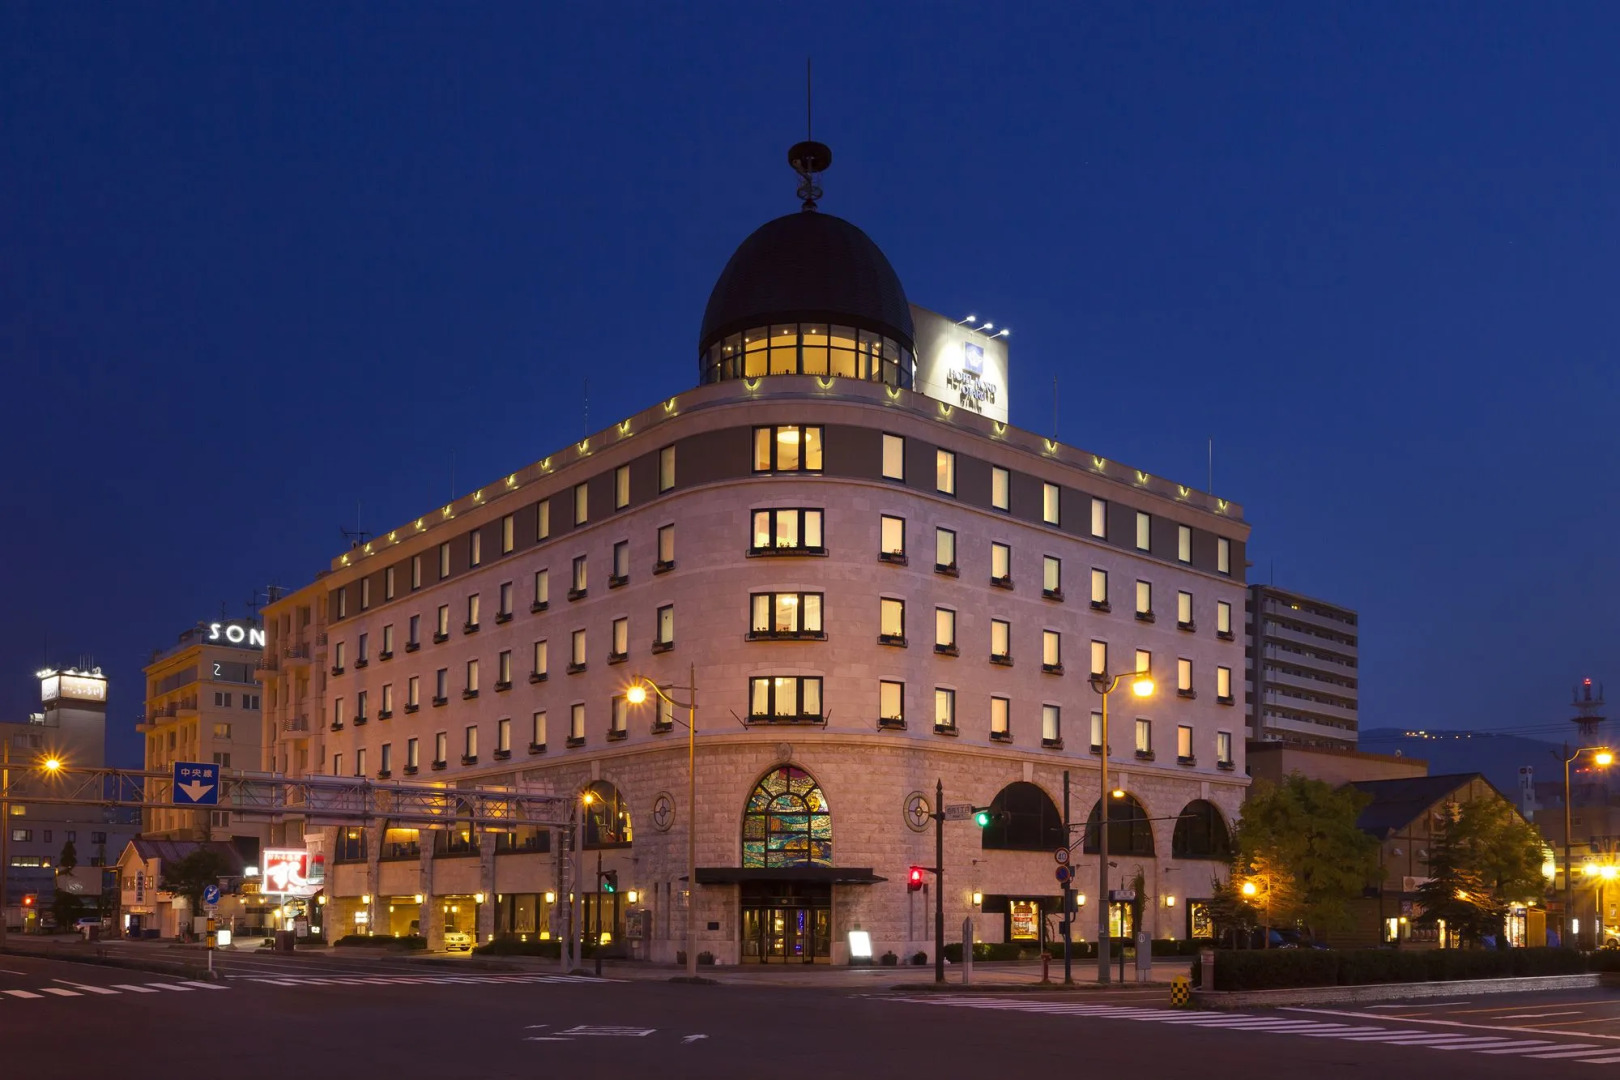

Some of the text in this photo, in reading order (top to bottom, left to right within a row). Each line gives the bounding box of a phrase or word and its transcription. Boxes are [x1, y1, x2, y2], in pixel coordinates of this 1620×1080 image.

[180, 767, 213, 778] 中央線
[1057, 852, 1067, 860] 40
